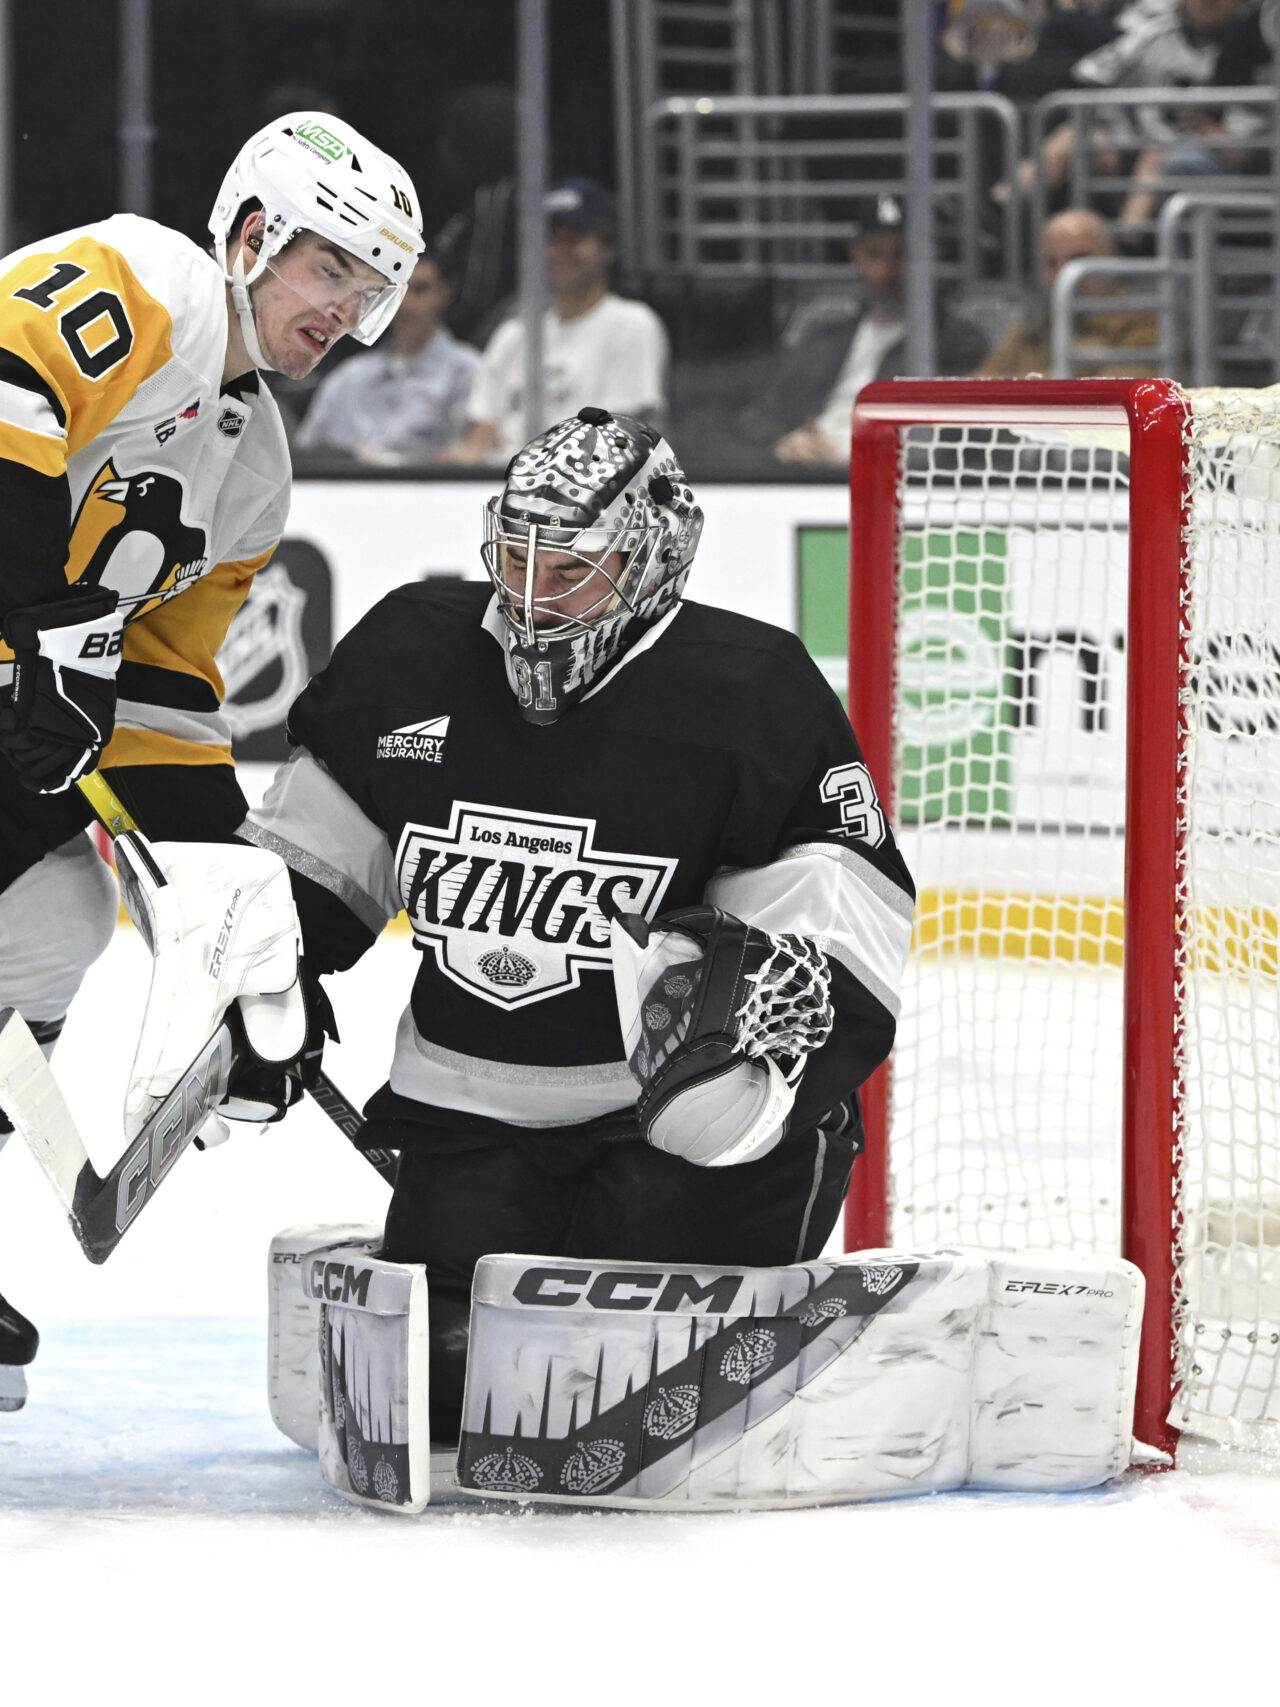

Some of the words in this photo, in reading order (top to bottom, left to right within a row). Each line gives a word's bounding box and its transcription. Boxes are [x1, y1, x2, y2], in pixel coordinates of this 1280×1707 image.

[297, 124, 345, 160] MSA
[390, 183, 413, 218] 10
[13, 262, 135, 383] 10
[376, 747, 443, 763] INSURANCE
[378, 735, 445, 752] MERCURY
[470, 826, 502, 845] Los
[504, 831, 572, 854] Angeles
[407, 847, 644, 948] KINGS
[115, 1041, 224, 1234] CCM
[311, 1260, 373, 1307] CCM
[512, 1267, 744, 1313] CCM
